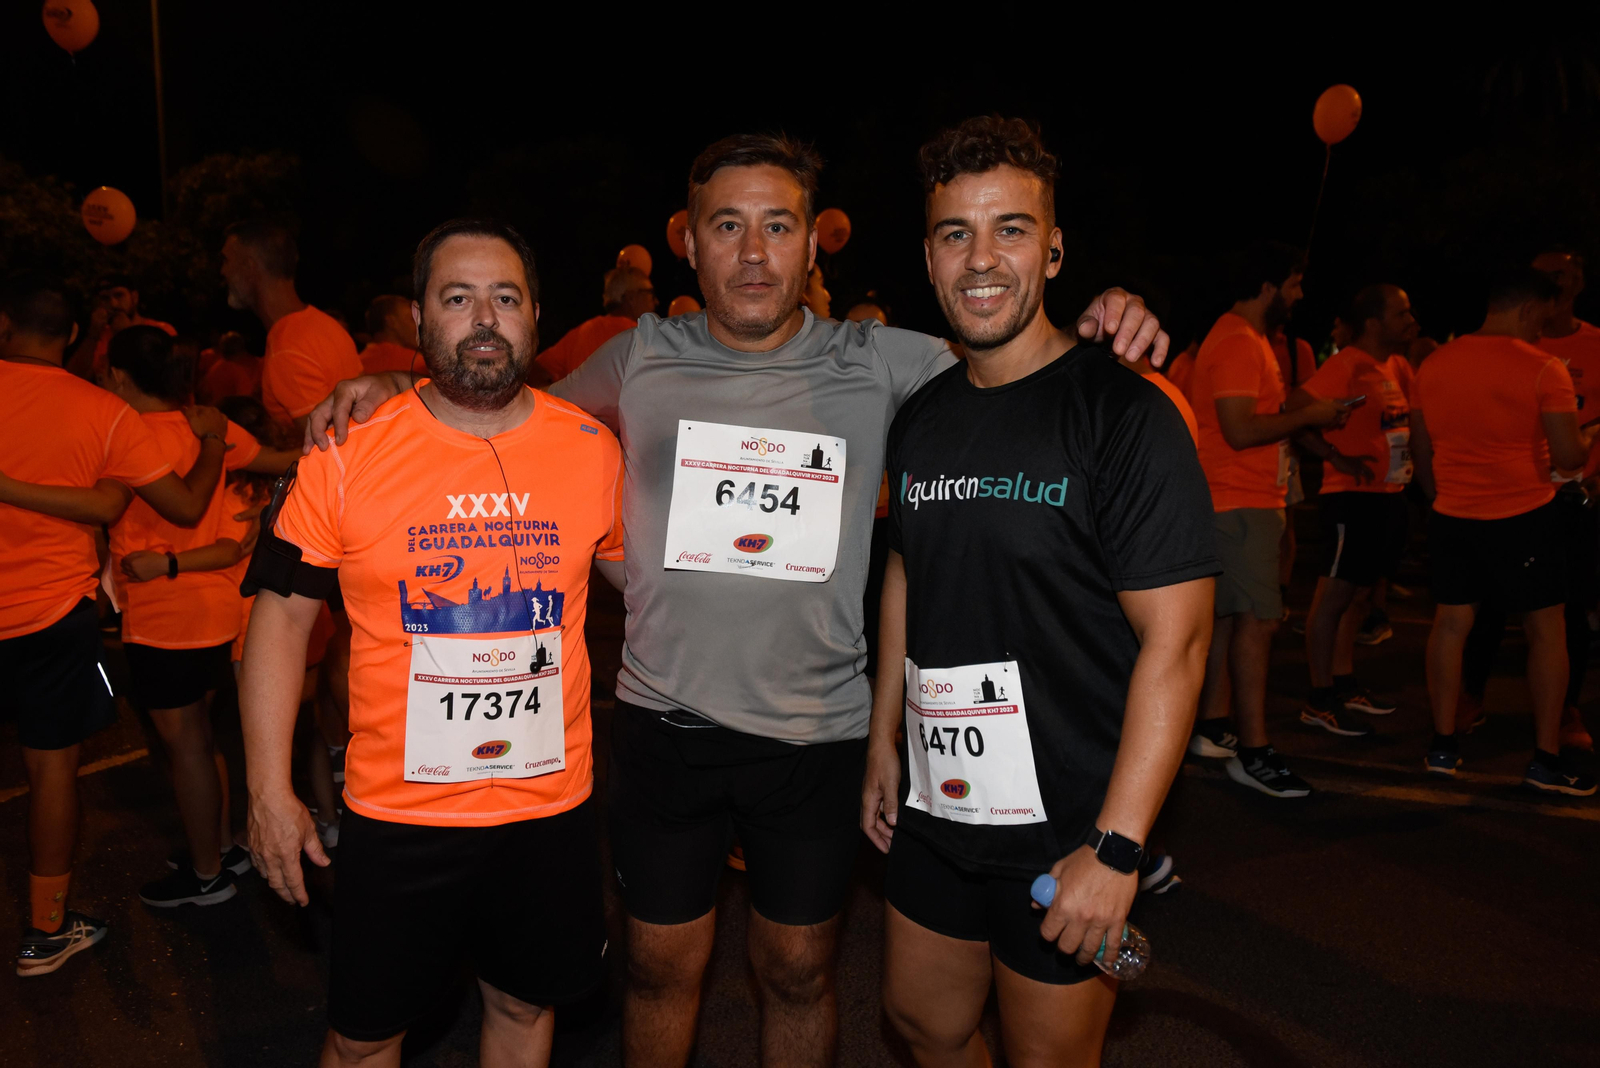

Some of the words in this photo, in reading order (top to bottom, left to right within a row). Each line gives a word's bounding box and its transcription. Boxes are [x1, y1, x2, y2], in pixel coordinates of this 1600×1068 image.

[701, 461, 727, 470] CARRERA
[727, 464, 759, 473] NOCTURNA
[769, 468, 811, 479] GUADALQUIVIR
[715, 479, 801, 516] 6454
[446, 493, 531, 519] XXXV
[408, 522, 478, 537] CARRERA
[484, 520, 559, 532] NOCTURNA
[419, 533, 560, 551] GUADALQUIVIR
[785, 563, 826, 574] Cruzcampo
[405, 623, 429, 632] 2023
[433, 676, 459, 684] CARRERA
[440, 686, 541, 721] 17374
[945, 709, 987, 717] GUADALQUIVIR
[525, 757, 560, 770] Cruzcampo
[990, 807, 1034, 816] Cruzcampo
